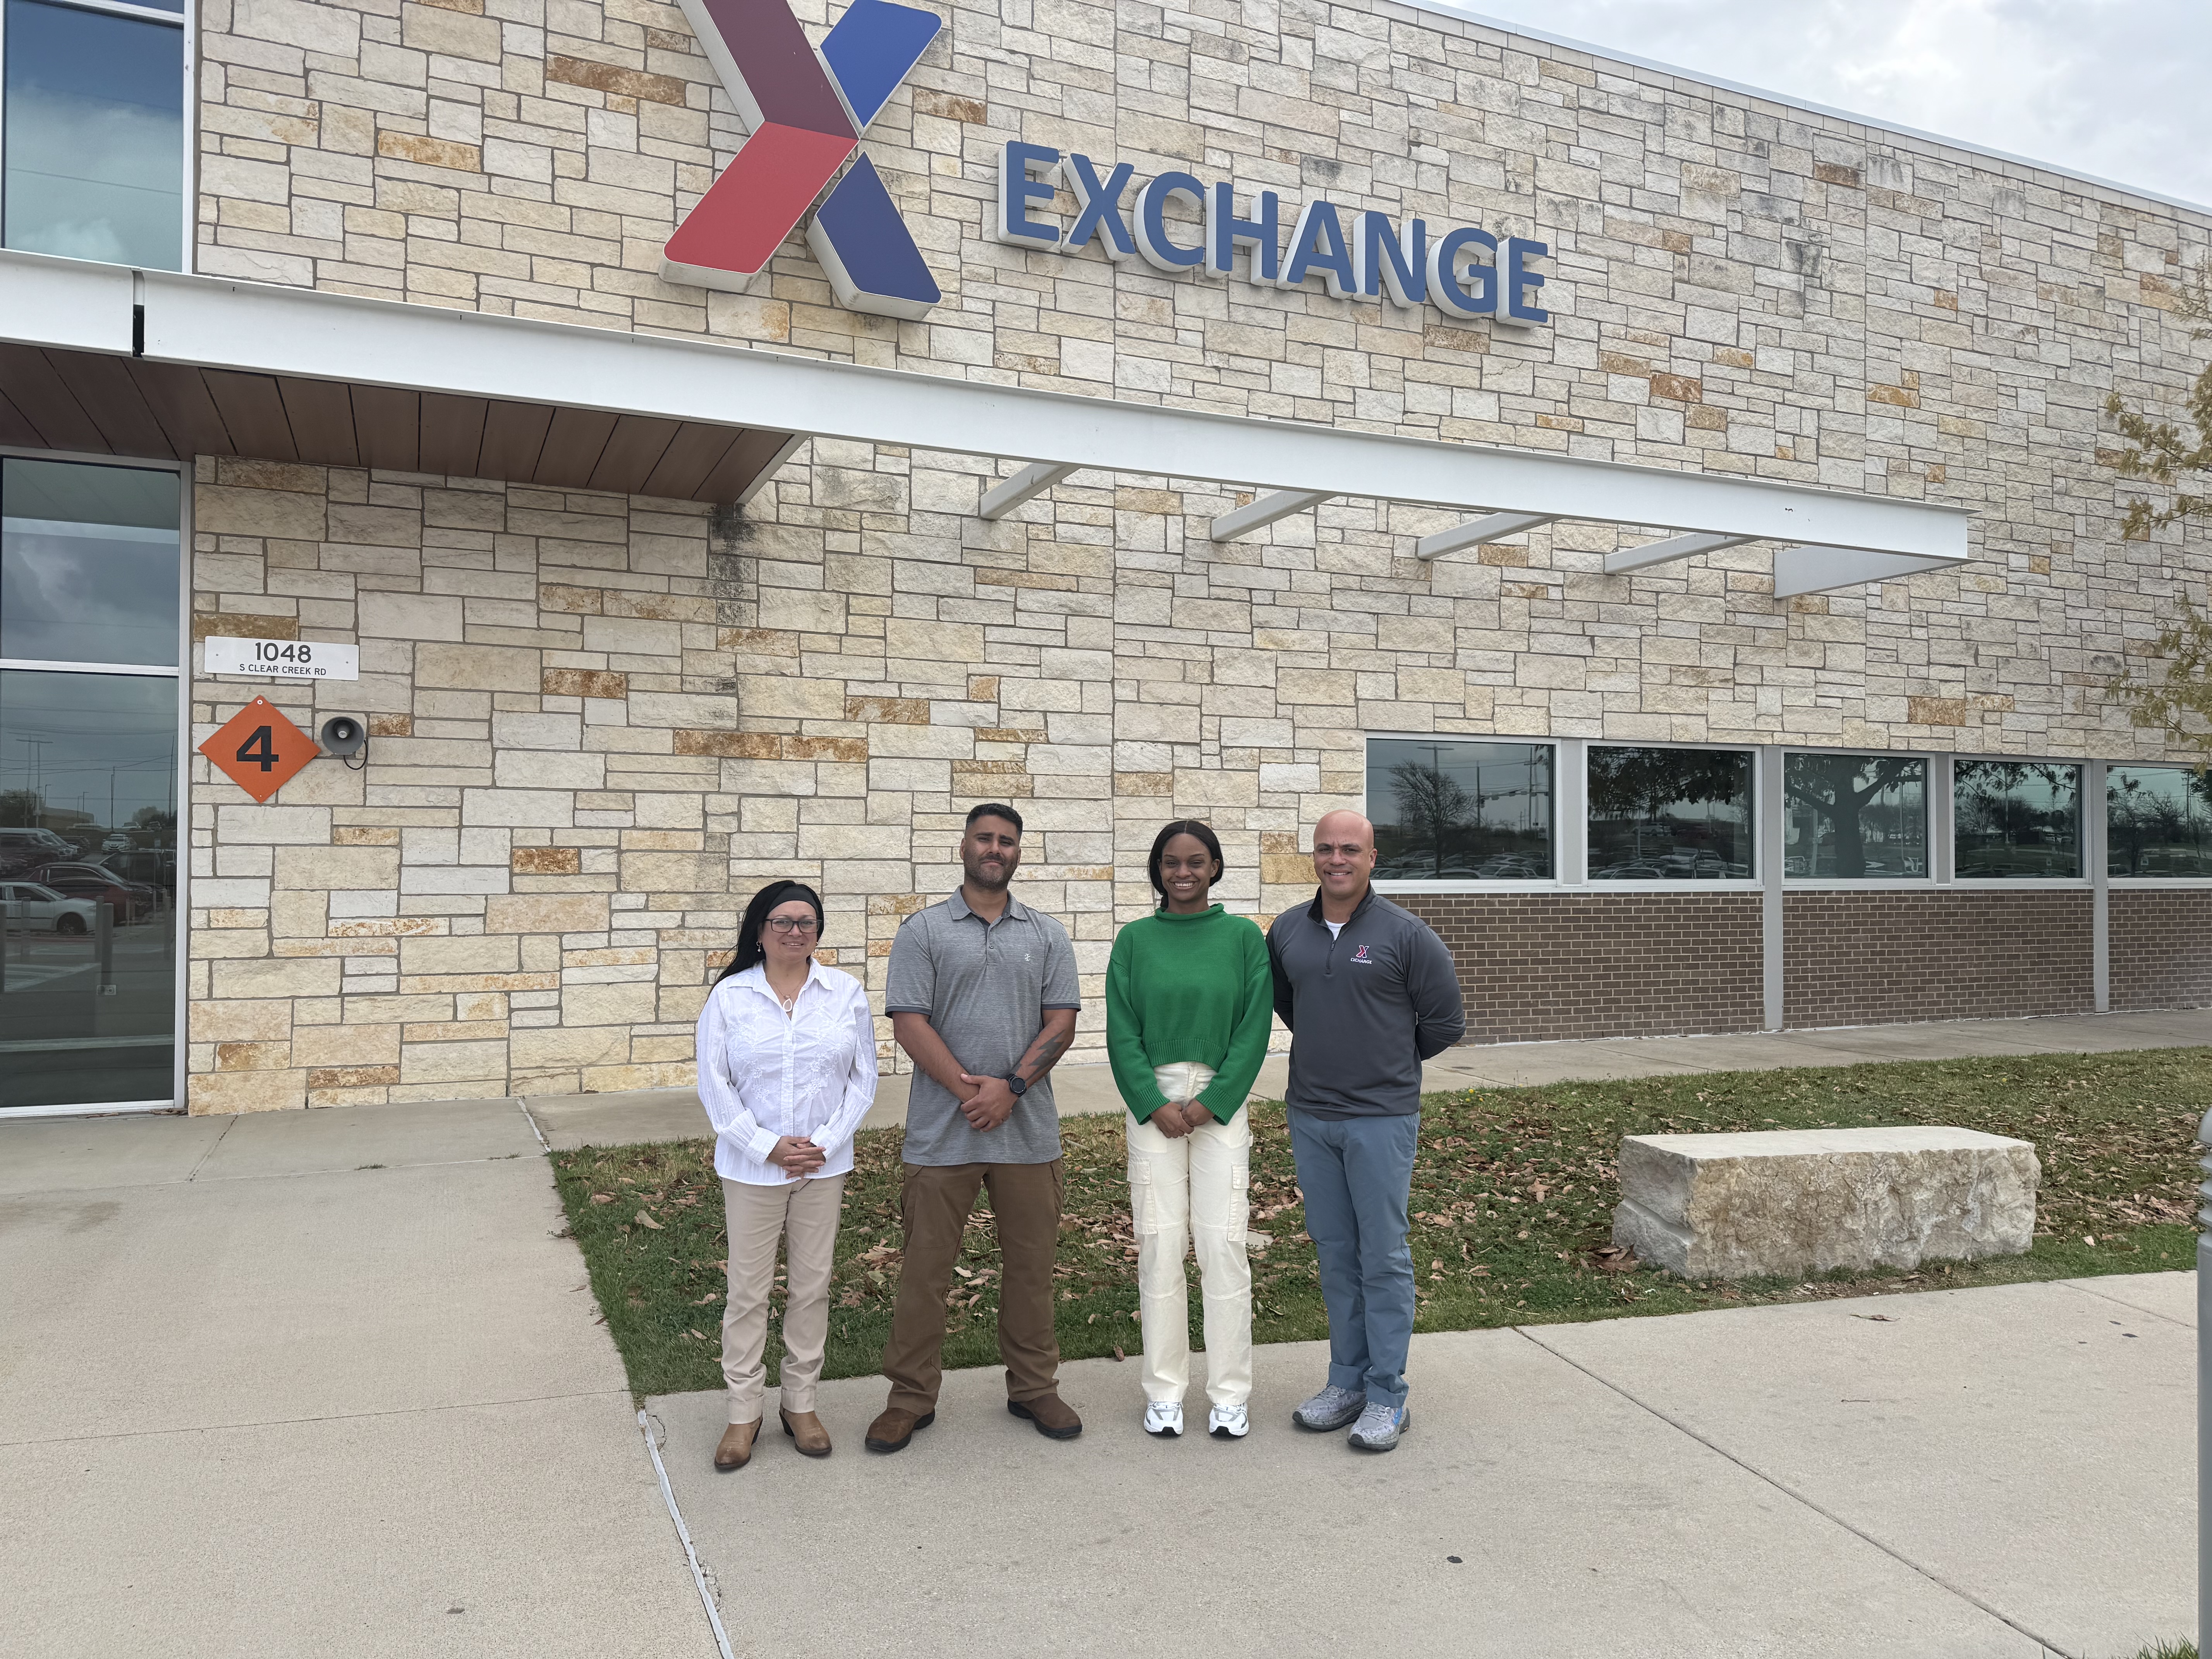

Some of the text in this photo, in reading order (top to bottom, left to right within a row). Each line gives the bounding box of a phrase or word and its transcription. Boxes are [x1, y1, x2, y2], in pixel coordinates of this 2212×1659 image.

[998, 140, 1548, 328] EXCHANGE
[255, 642, 311, 663] 1048
[248, 664, 278, 673] CLEAR
[282, 666, 311, 675] CREEK
[236, 726, 279, 772] 4
